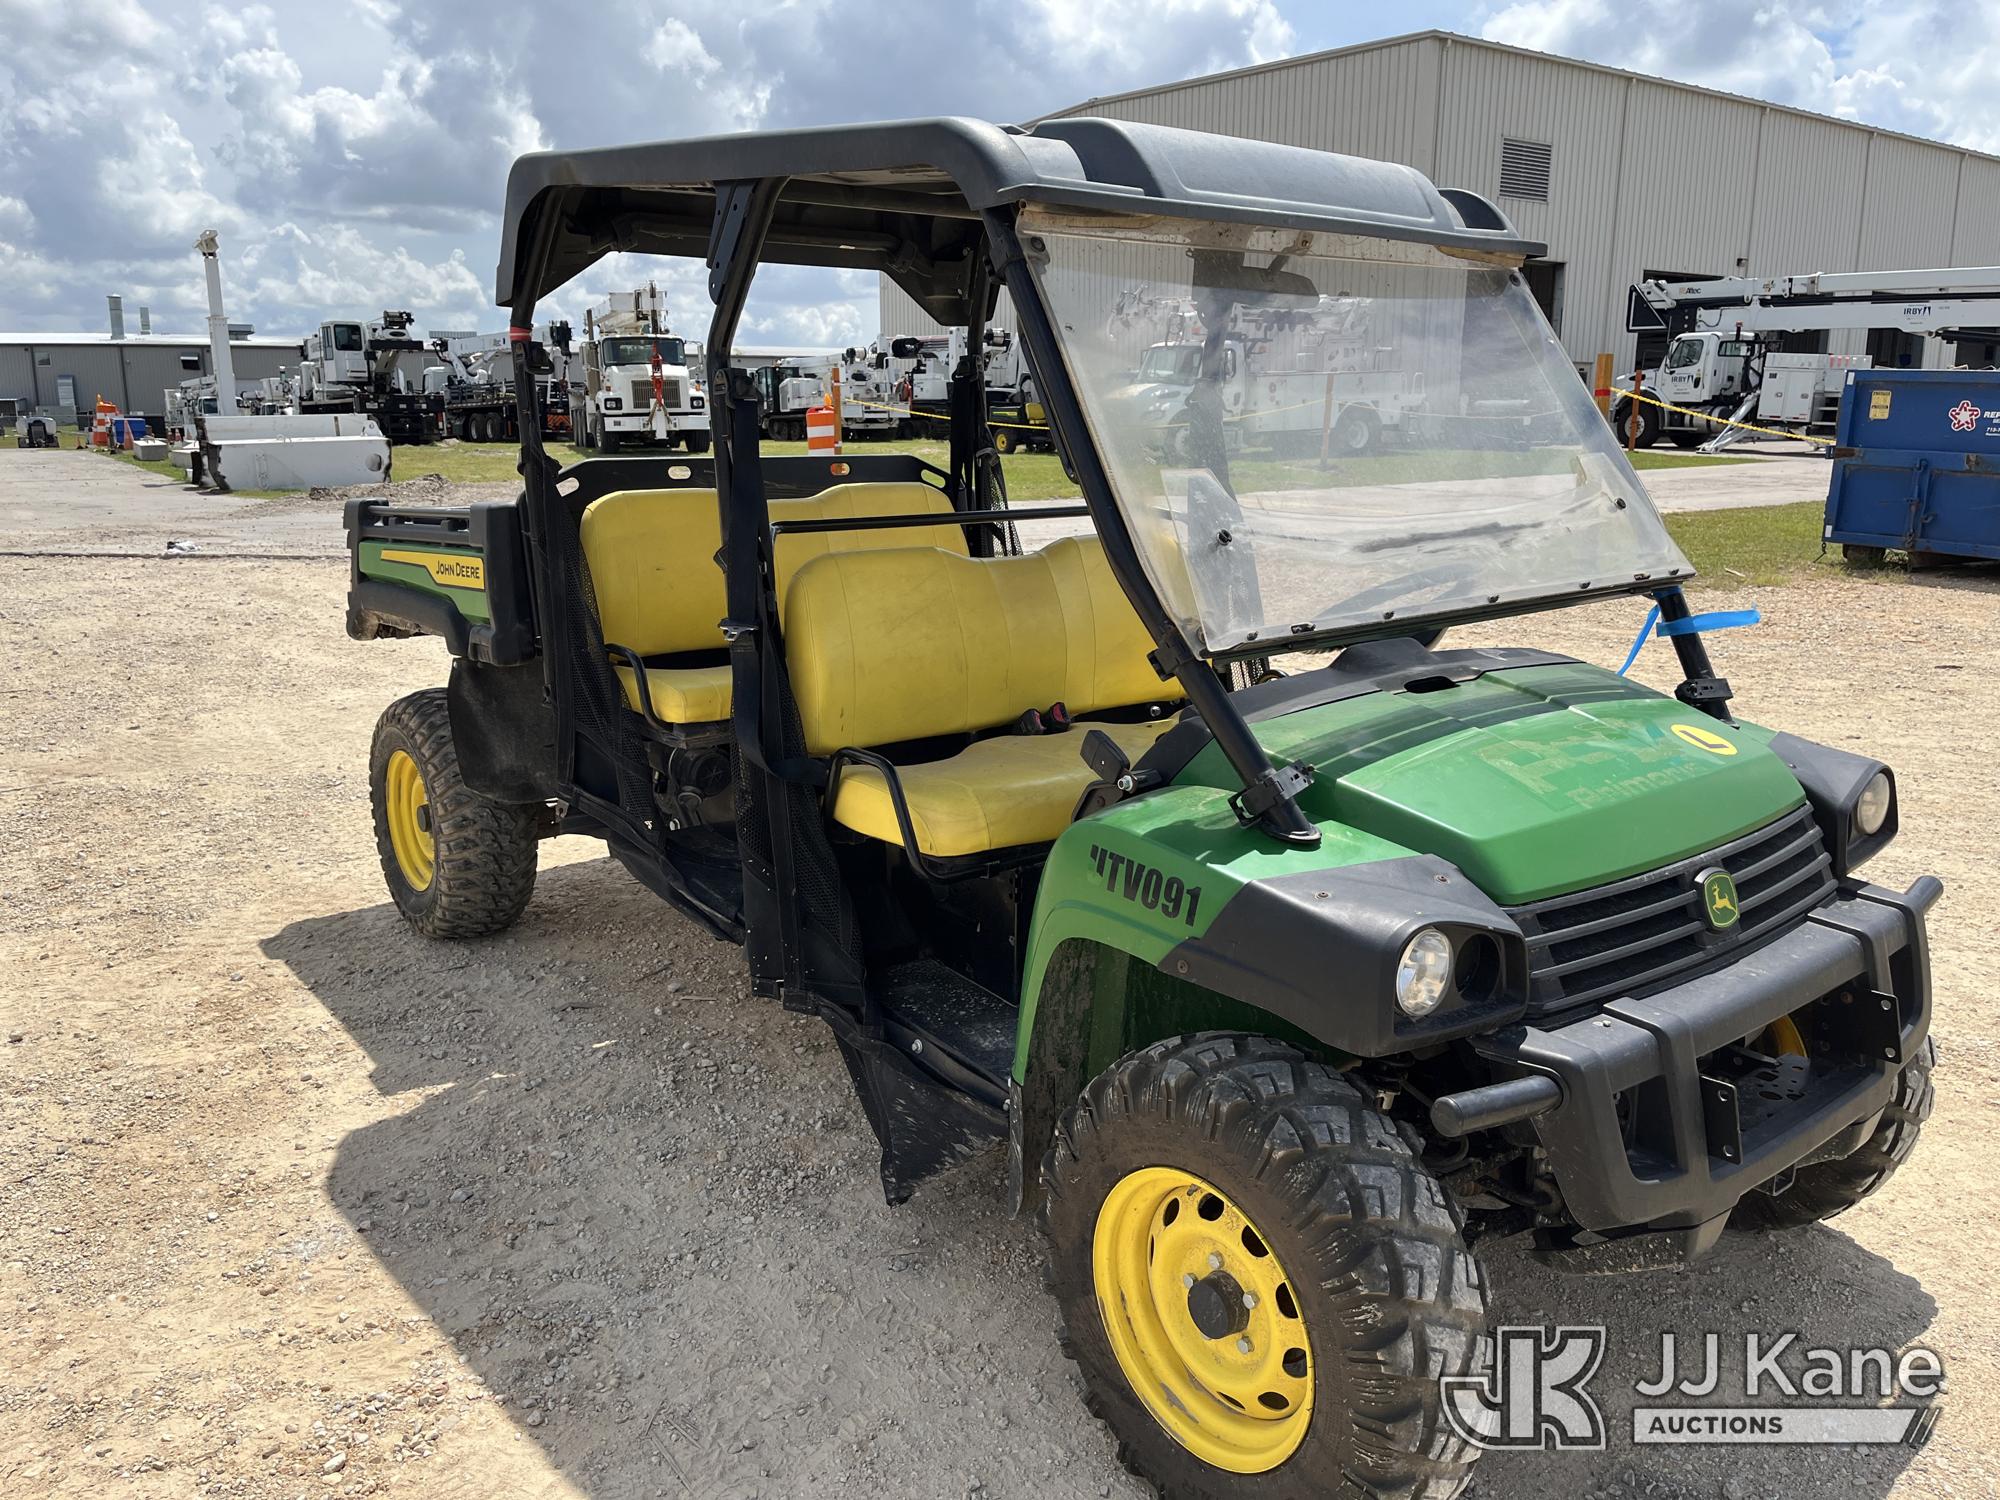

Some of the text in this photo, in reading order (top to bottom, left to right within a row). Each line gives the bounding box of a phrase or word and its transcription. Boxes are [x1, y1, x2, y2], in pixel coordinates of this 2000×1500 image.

[1903, 307, 1923, 315] IRBY
[436, 560, 480, 579] JOHN DEERE
